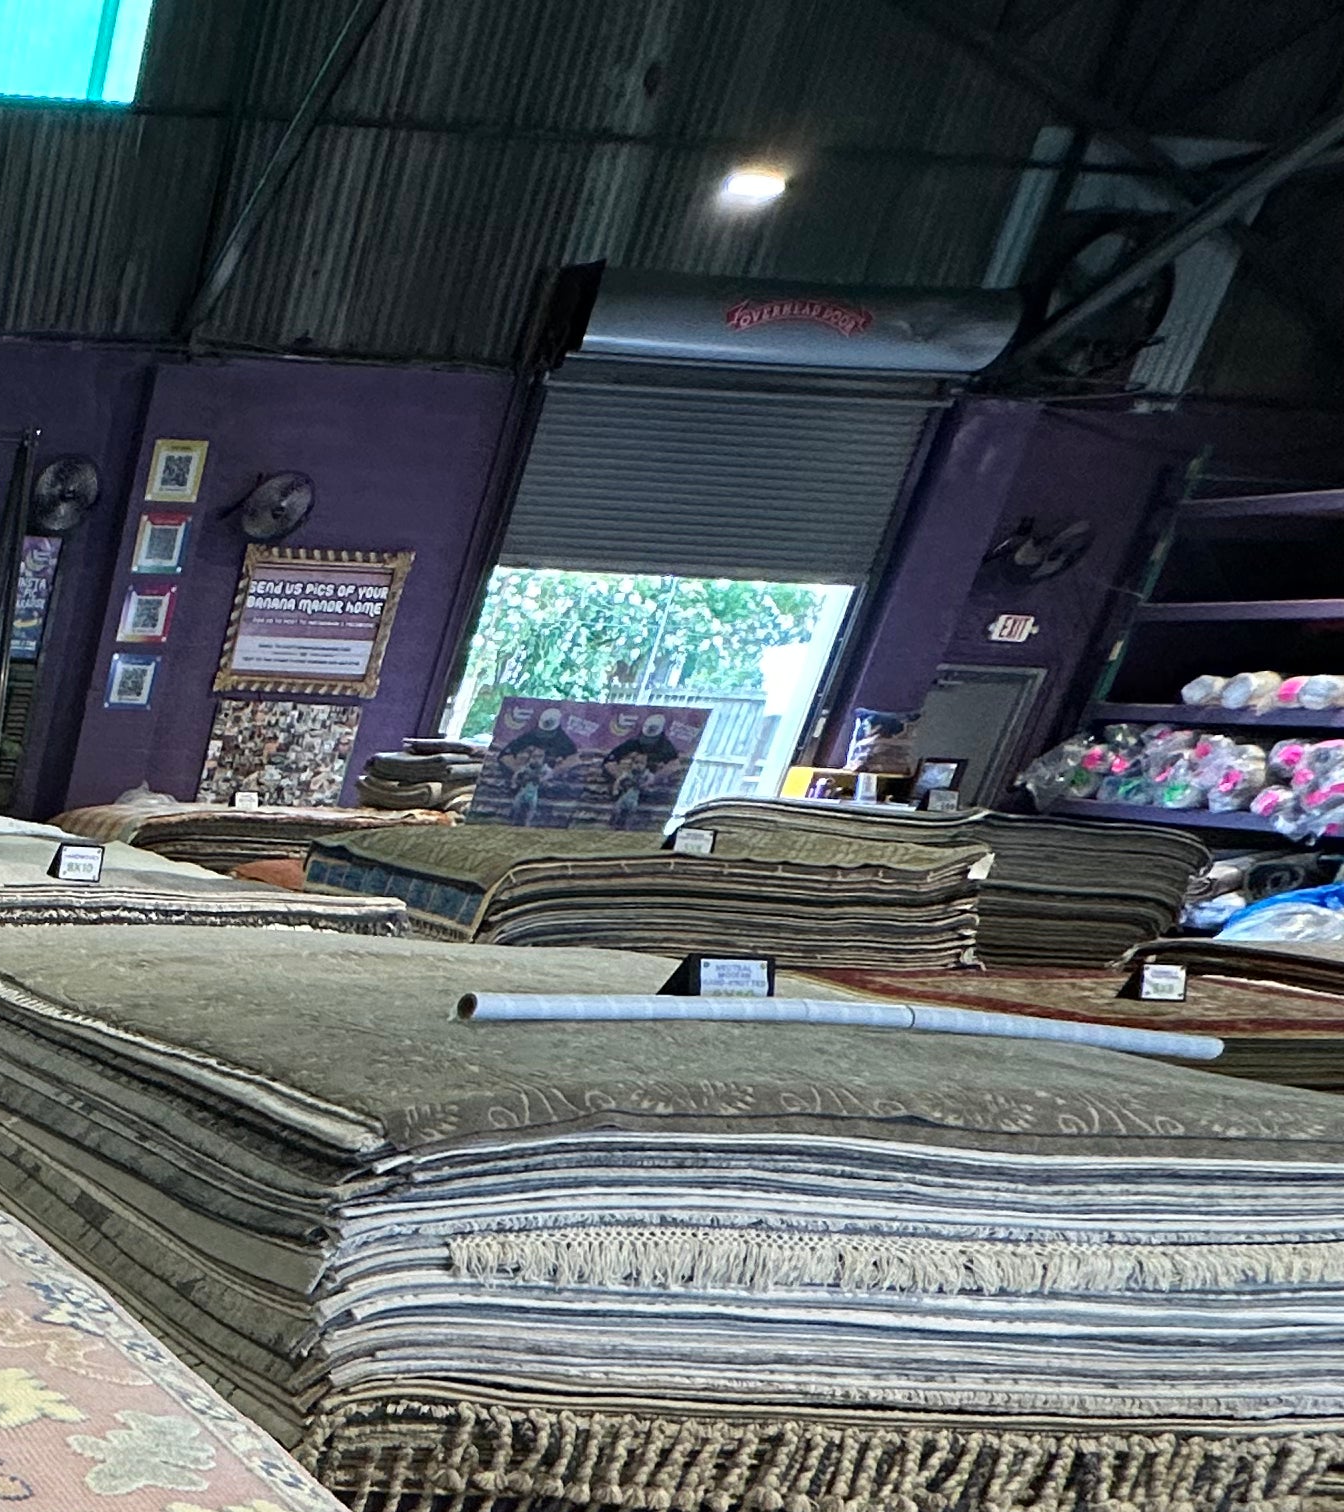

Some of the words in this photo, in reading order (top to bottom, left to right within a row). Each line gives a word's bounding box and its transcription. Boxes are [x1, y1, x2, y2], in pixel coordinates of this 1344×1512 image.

[285, 583, 303, 594] US
[338, 584, 355, 597] OF
[358, 586, 389, 600] YOUR
[999, 617, 1031, 640] EXIT
